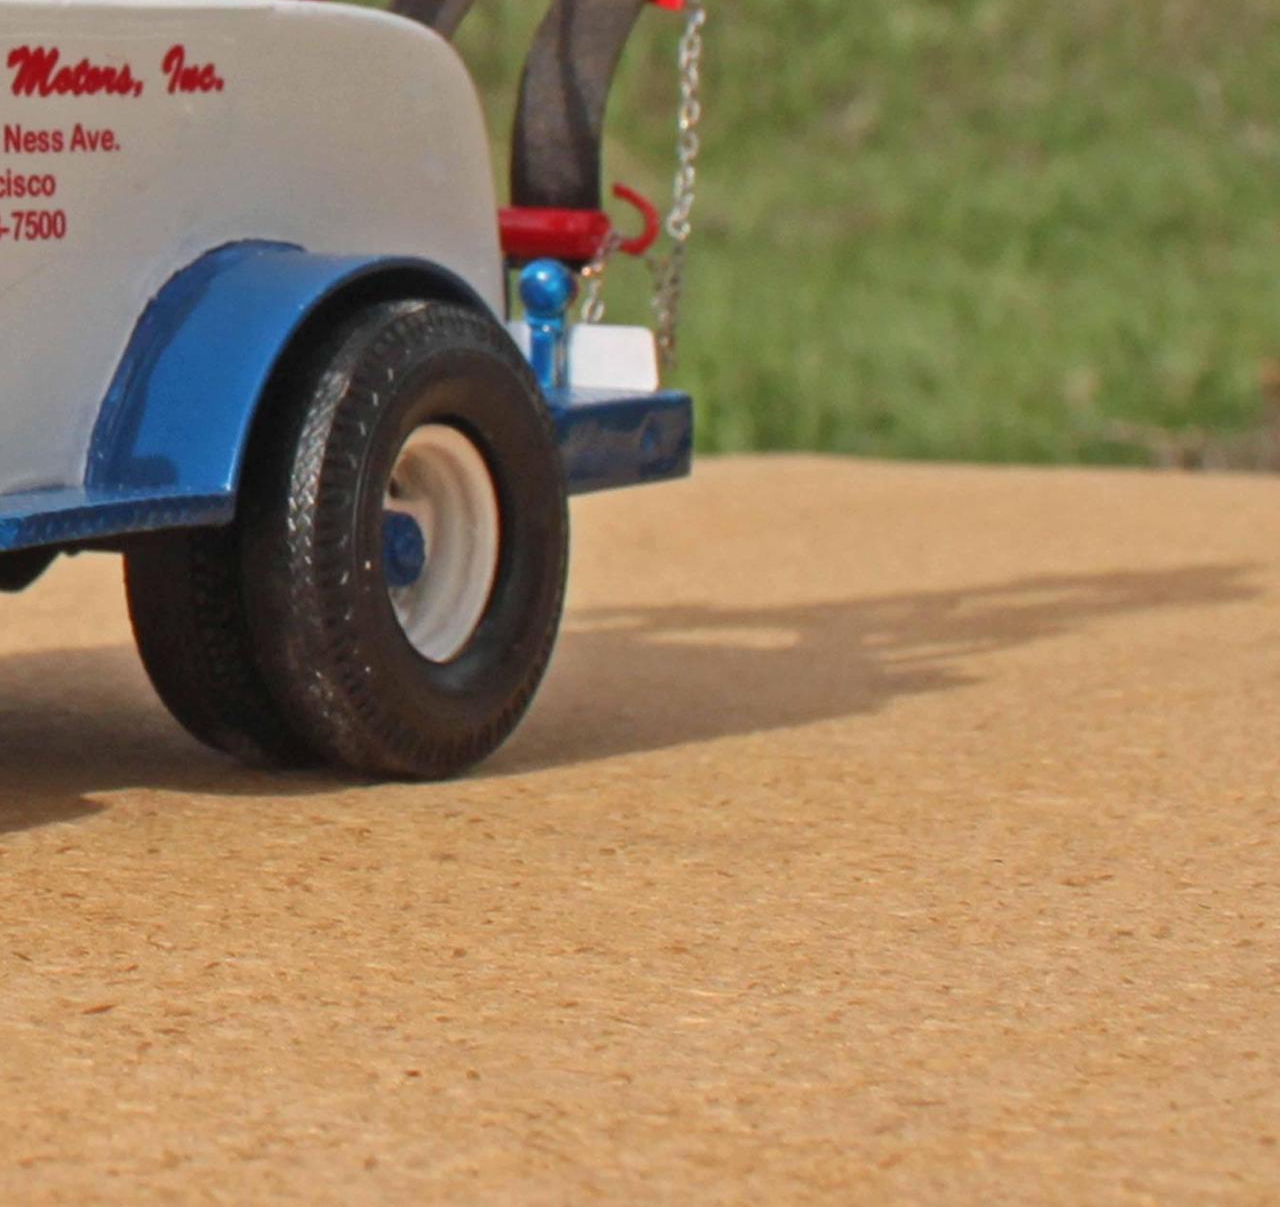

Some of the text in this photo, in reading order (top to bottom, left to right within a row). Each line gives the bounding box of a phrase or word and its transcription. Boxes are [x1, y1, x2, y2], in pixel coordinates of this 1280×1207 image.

[6, 44, 143, 98] Motors,
[161, 44, 225, 94] Inc.
[3, 124, 64, 154] Ness
[70, 123, 121, 153] Ave.
